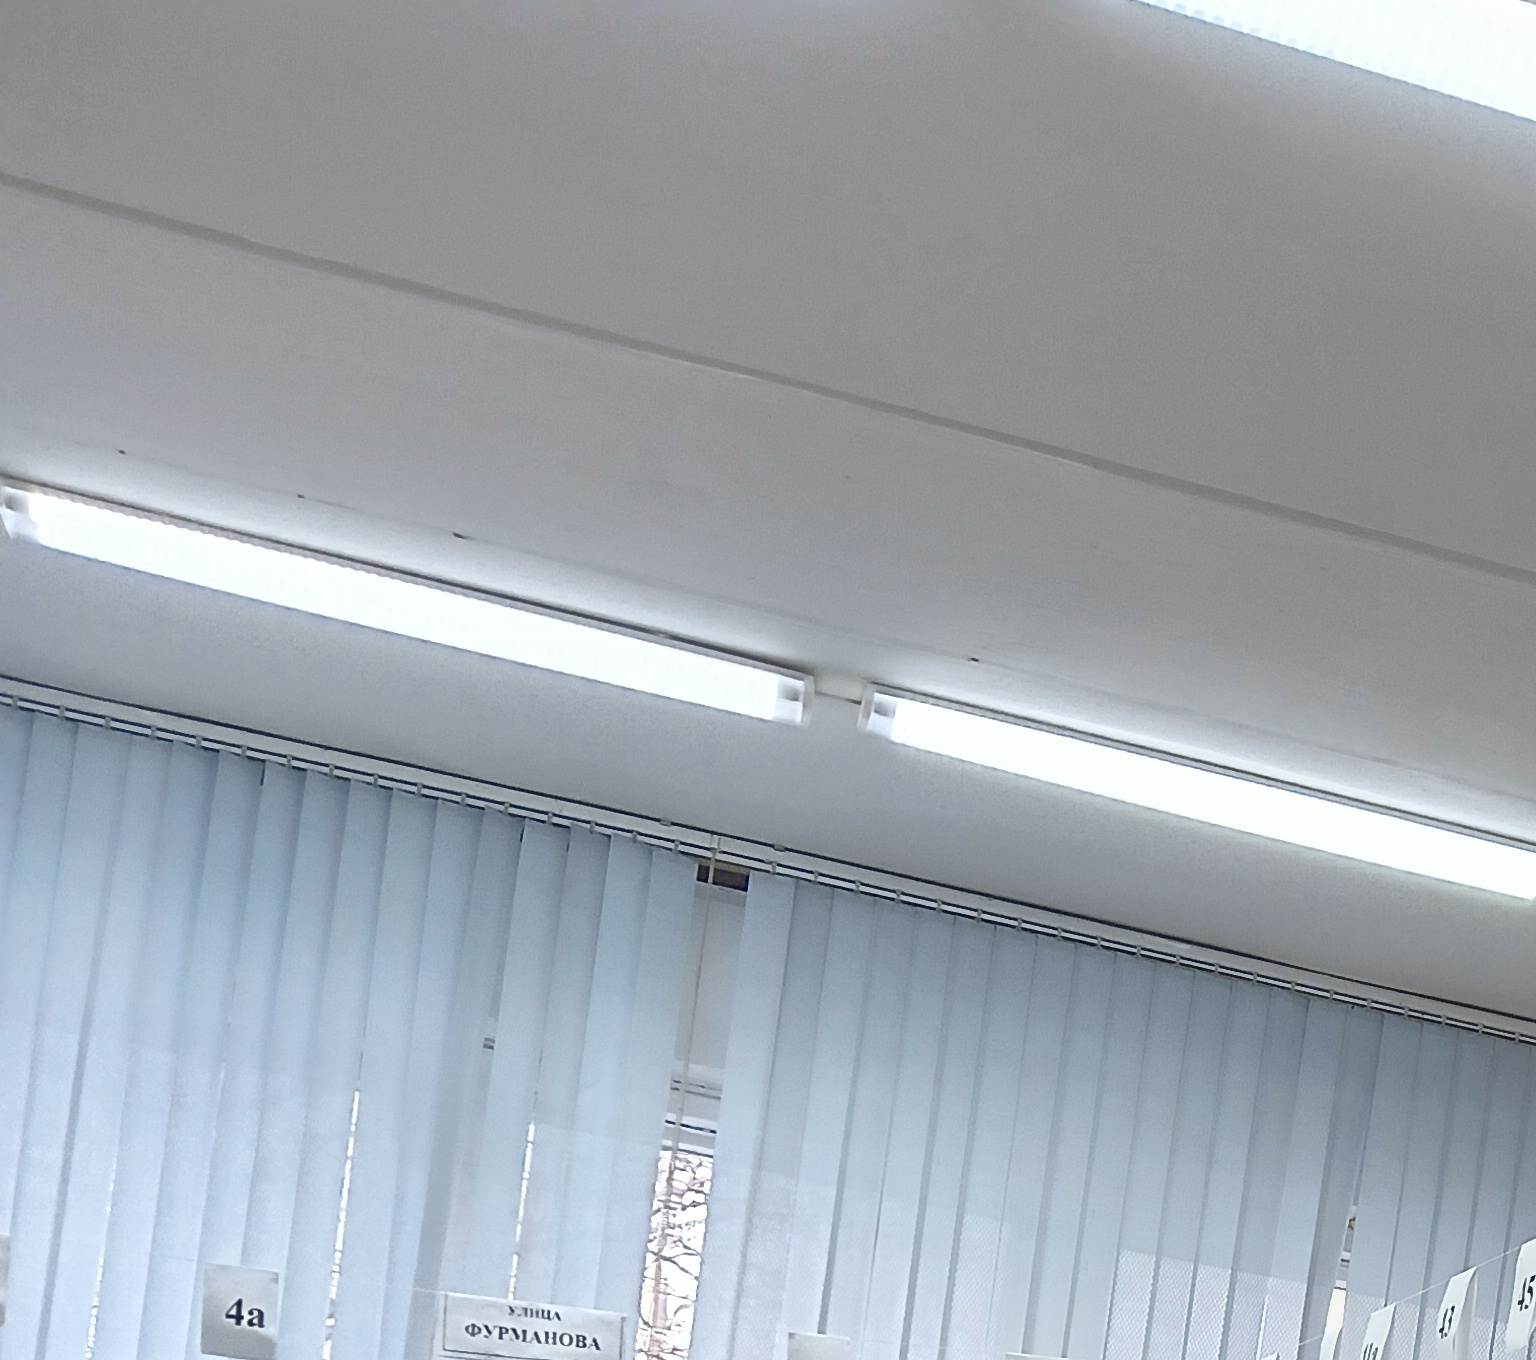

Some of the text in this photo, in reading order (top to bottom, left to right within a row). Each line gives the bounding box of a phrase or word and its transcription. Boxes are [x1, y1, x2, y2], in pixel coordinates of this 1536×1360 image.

[1517, 1274, 1536, 1312] 45
[224, 1297, 266, 1329] 4а
[507, 1304, 562, 1322] УЛИЦА
[1438, 1304, 1456, 1340] 43
[464, 1322, 602, 1351] ФУРМАНОВА
